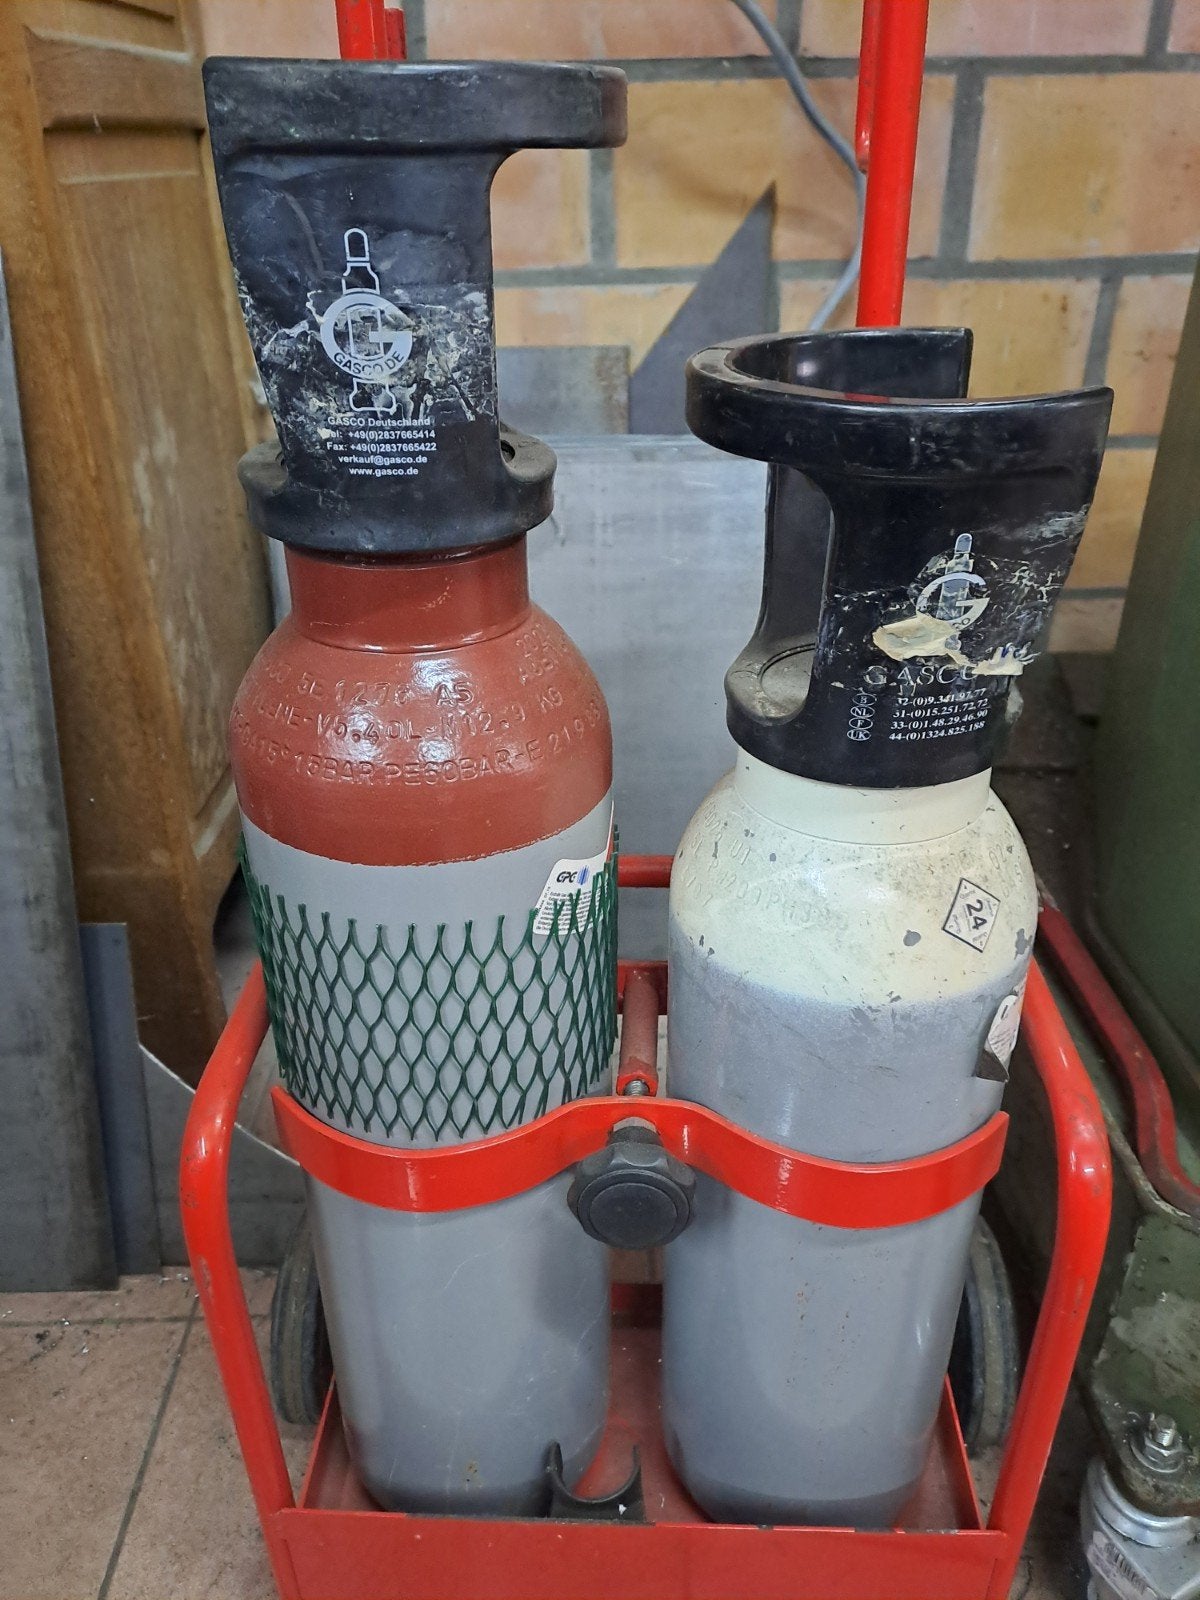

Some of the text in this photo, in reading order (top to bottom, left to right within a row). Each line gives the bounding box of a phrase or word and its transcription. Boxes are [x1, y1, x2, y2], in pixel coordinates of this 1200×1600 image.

[334, 350, 404, 376] GASCO DE
[327, 416, 431, 427] GASCO Deutschland
[325, 429, 435, 442] el: +49(0)2837665414
[326, 441, 437, 454] Fax: +49(0)2837665422
[338, 455, 428, 466] verkauf@gasco.de
[349, 467, 419, 477] www.gasco.de
[965, 898, 988, 931] 24
